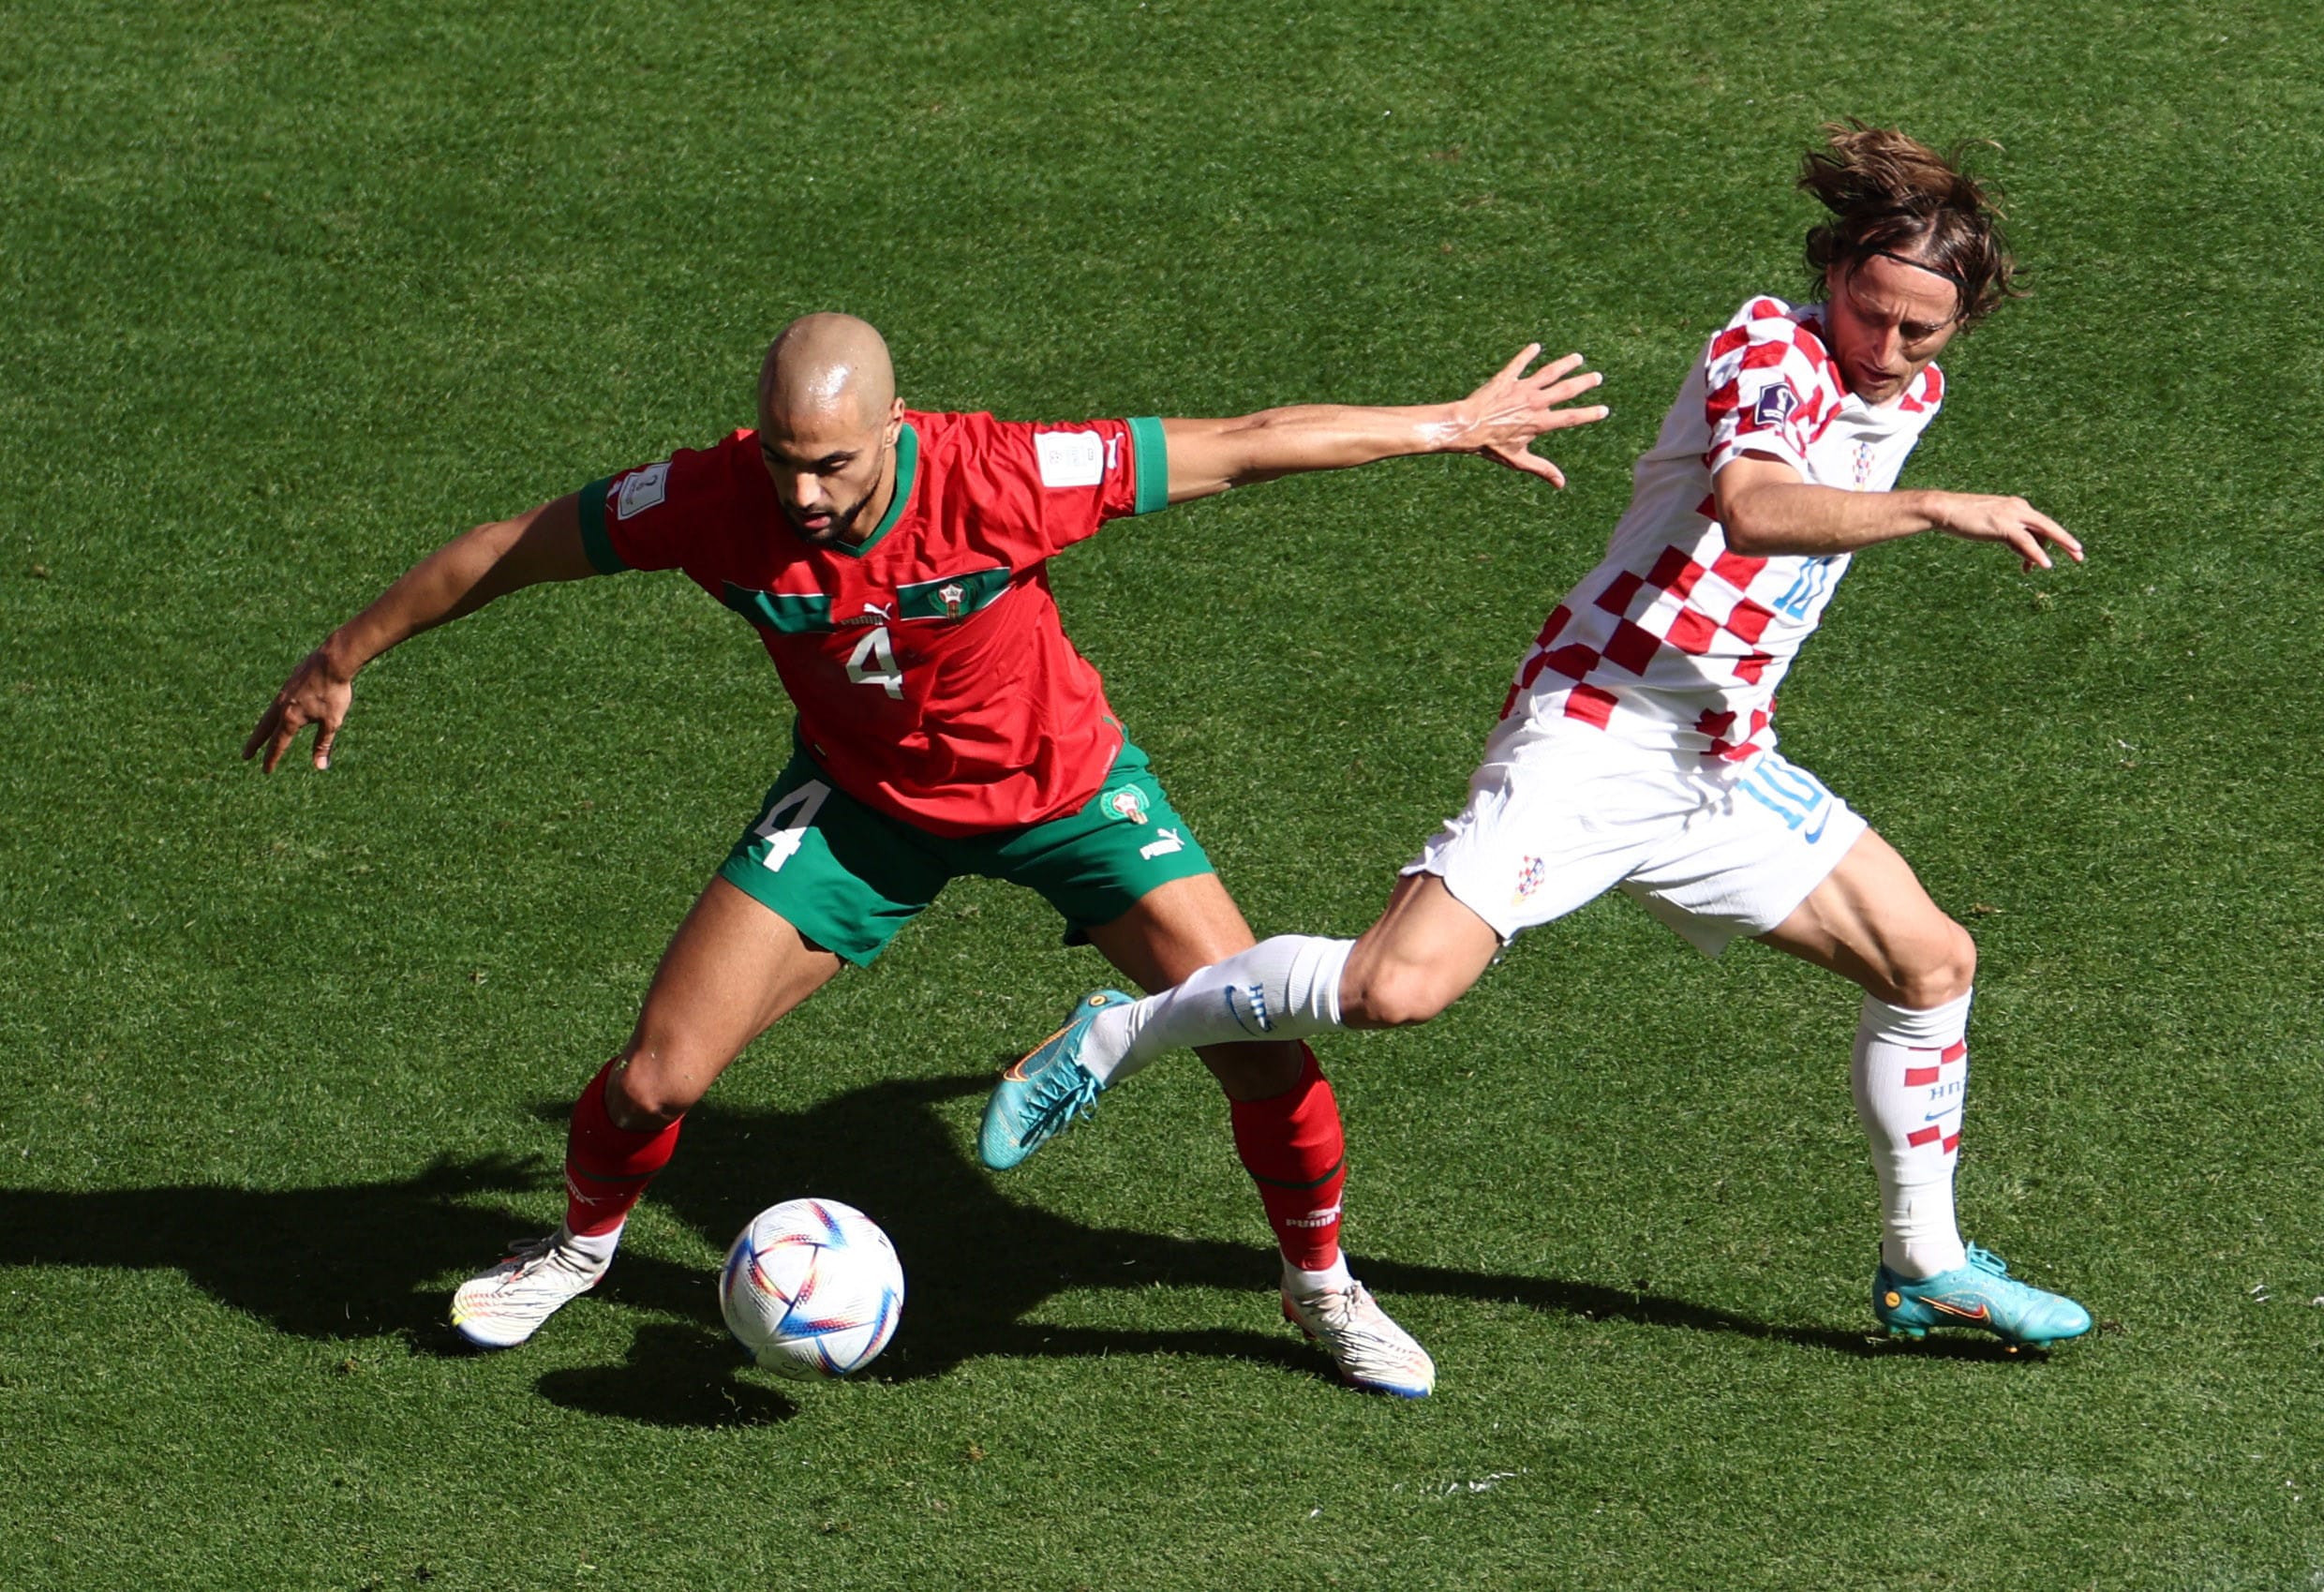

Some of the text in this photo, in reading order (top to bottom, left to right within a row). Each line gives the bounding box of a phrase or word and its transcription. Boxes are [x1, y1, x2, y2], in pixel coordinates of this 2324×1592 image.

[1772, 557, 1835, 620] 10
[846, 627, 903, 700] 4
[753, 779, 831, 872] 4
[1736, 753, 1824, 830] 10
